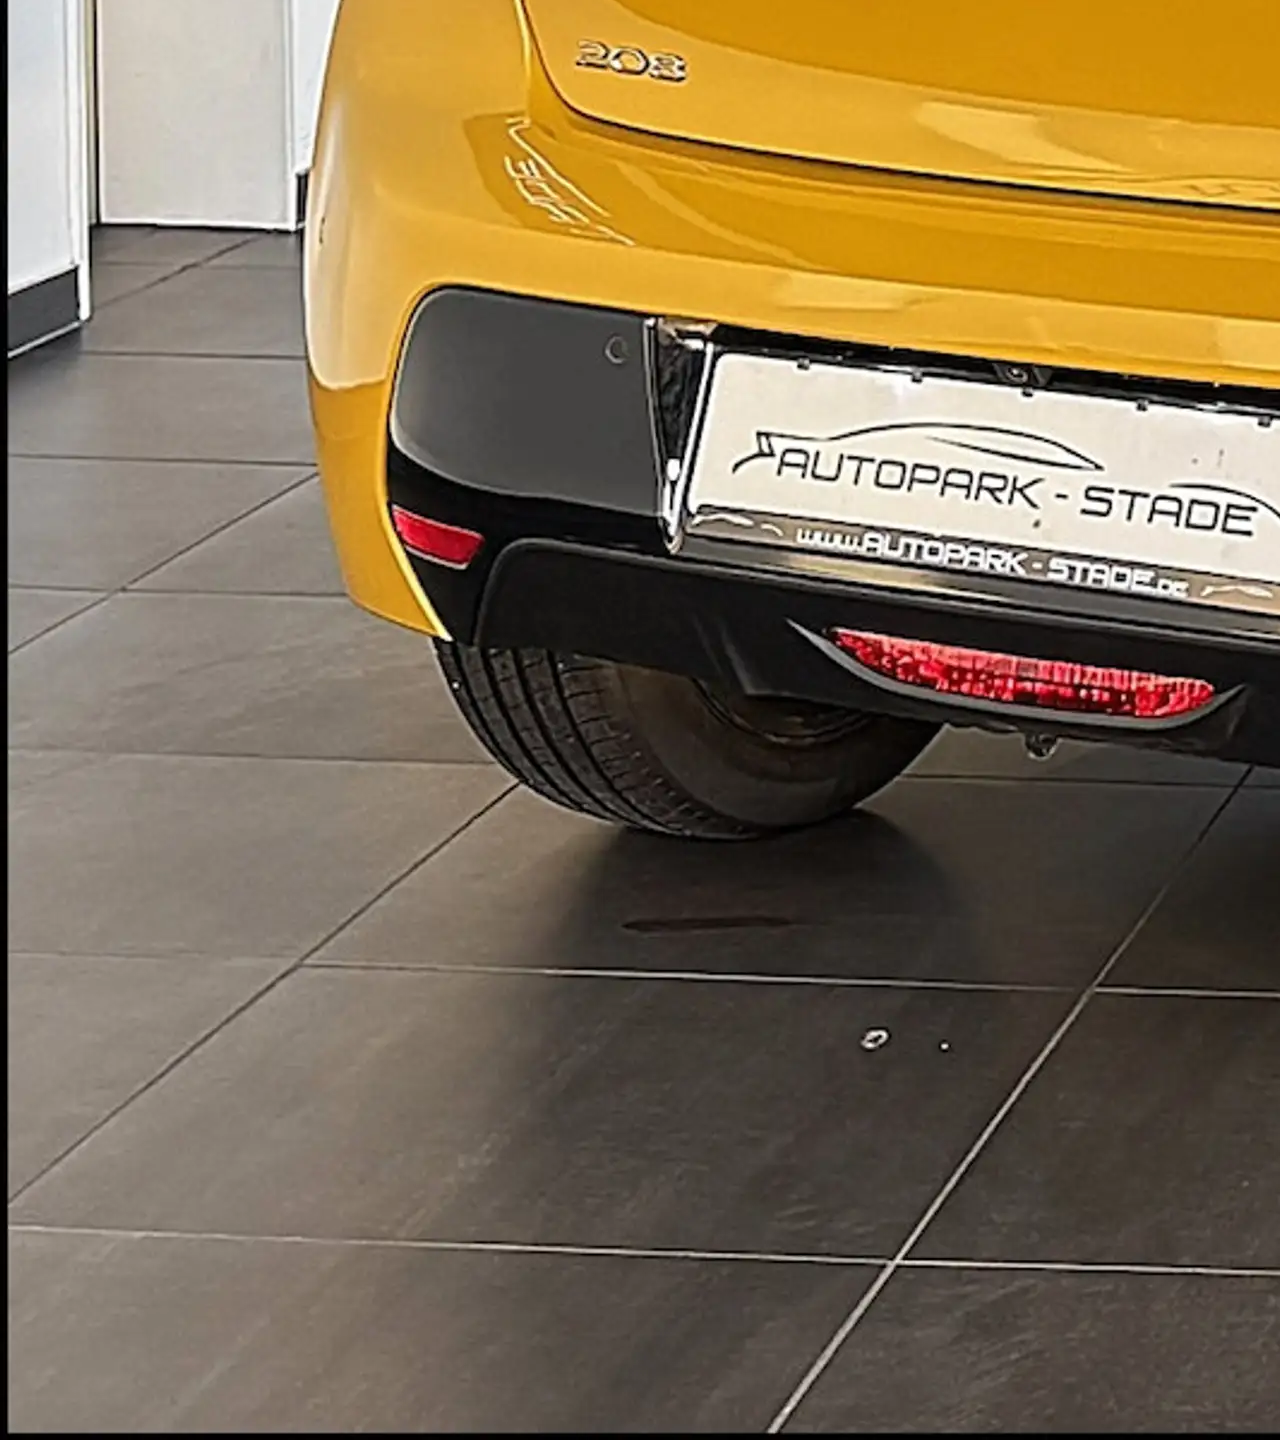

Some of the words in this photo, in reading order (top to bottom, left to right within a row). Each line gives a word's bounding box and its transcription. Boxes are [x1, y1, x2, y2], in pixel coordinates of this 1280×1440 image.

[575, 39, 688, 82] 208
[776, 448, 1046, 509] AUTOPARK
[1080, 486, 1258, 536] STADE
[796, 527, 1028, 575] www.AUTOPARK
